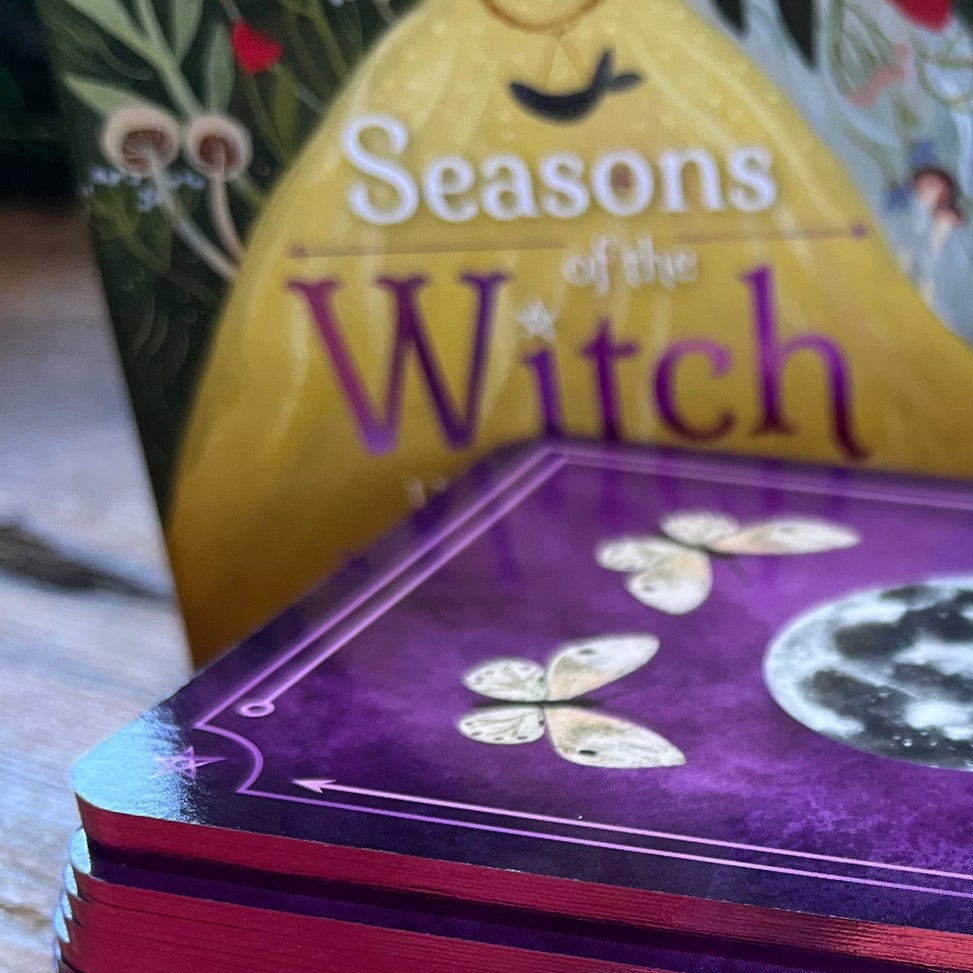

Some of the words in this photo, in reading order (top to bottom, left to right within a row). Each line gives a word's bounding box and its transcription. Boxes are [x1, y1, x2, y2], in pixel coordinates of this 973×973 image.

[342, 113, 778, 226] Seasons
[561, 234, 618, 297] of
[621, 233, 698, 290] the
[286, 263, 870, 460] Witch
